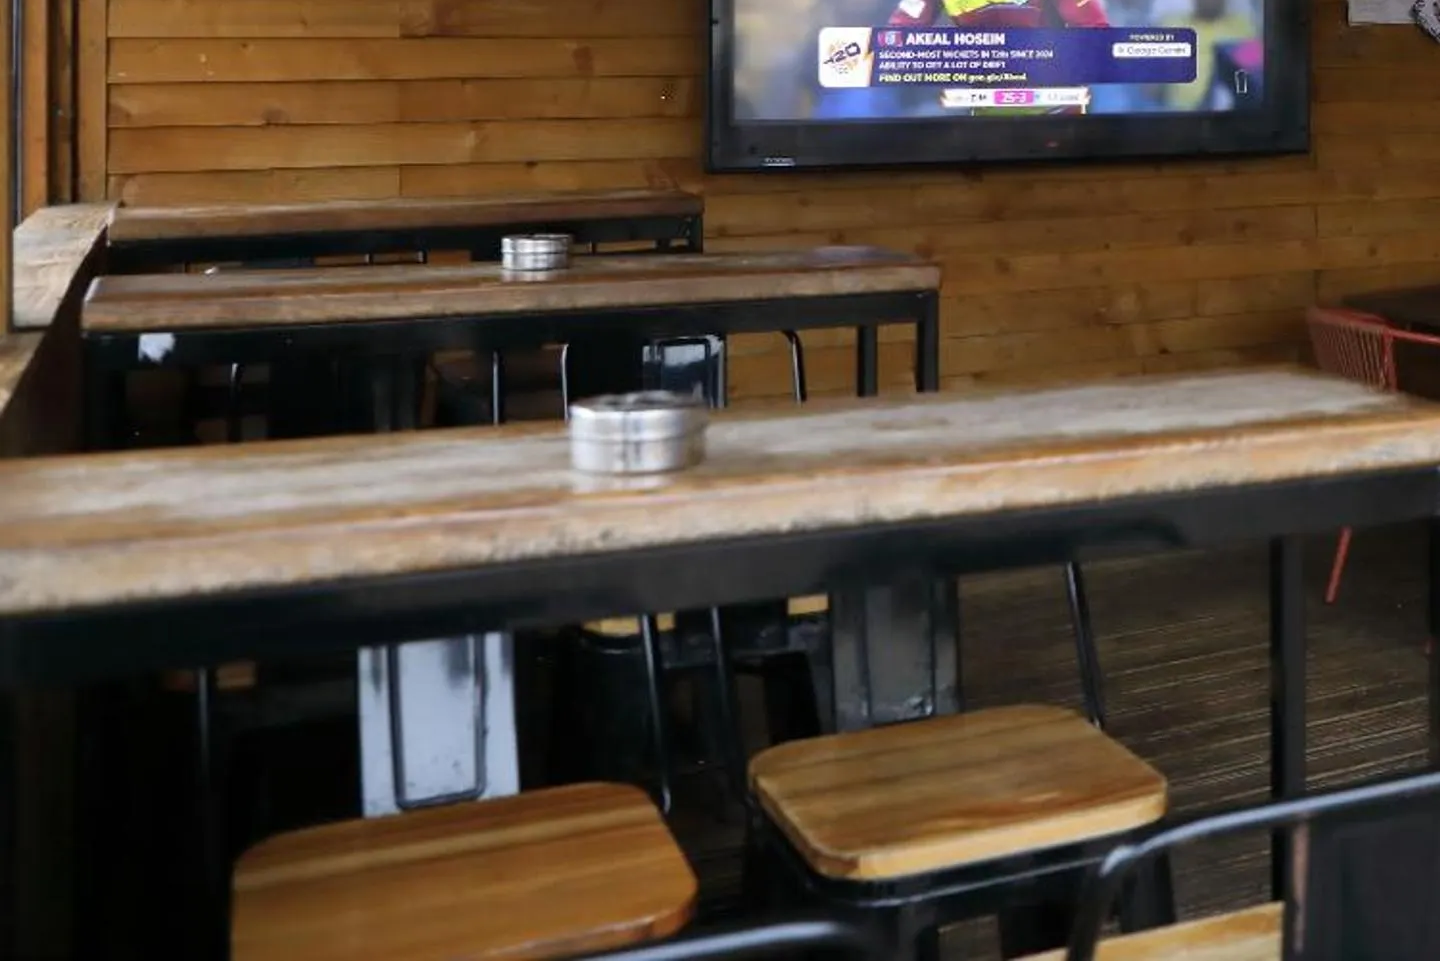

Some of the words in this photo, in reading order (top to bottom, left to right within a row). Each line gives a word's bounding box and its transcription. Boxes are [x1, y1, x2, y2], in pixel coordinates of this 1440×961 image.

[906, 33, 950, 45] AKEAL
[954, 33, 1005, 45] HOSEIN
[902, 73, 923, 82] OUT
[925, 73, 951, 82] MORE
[952, 73, 968, 82] ON
